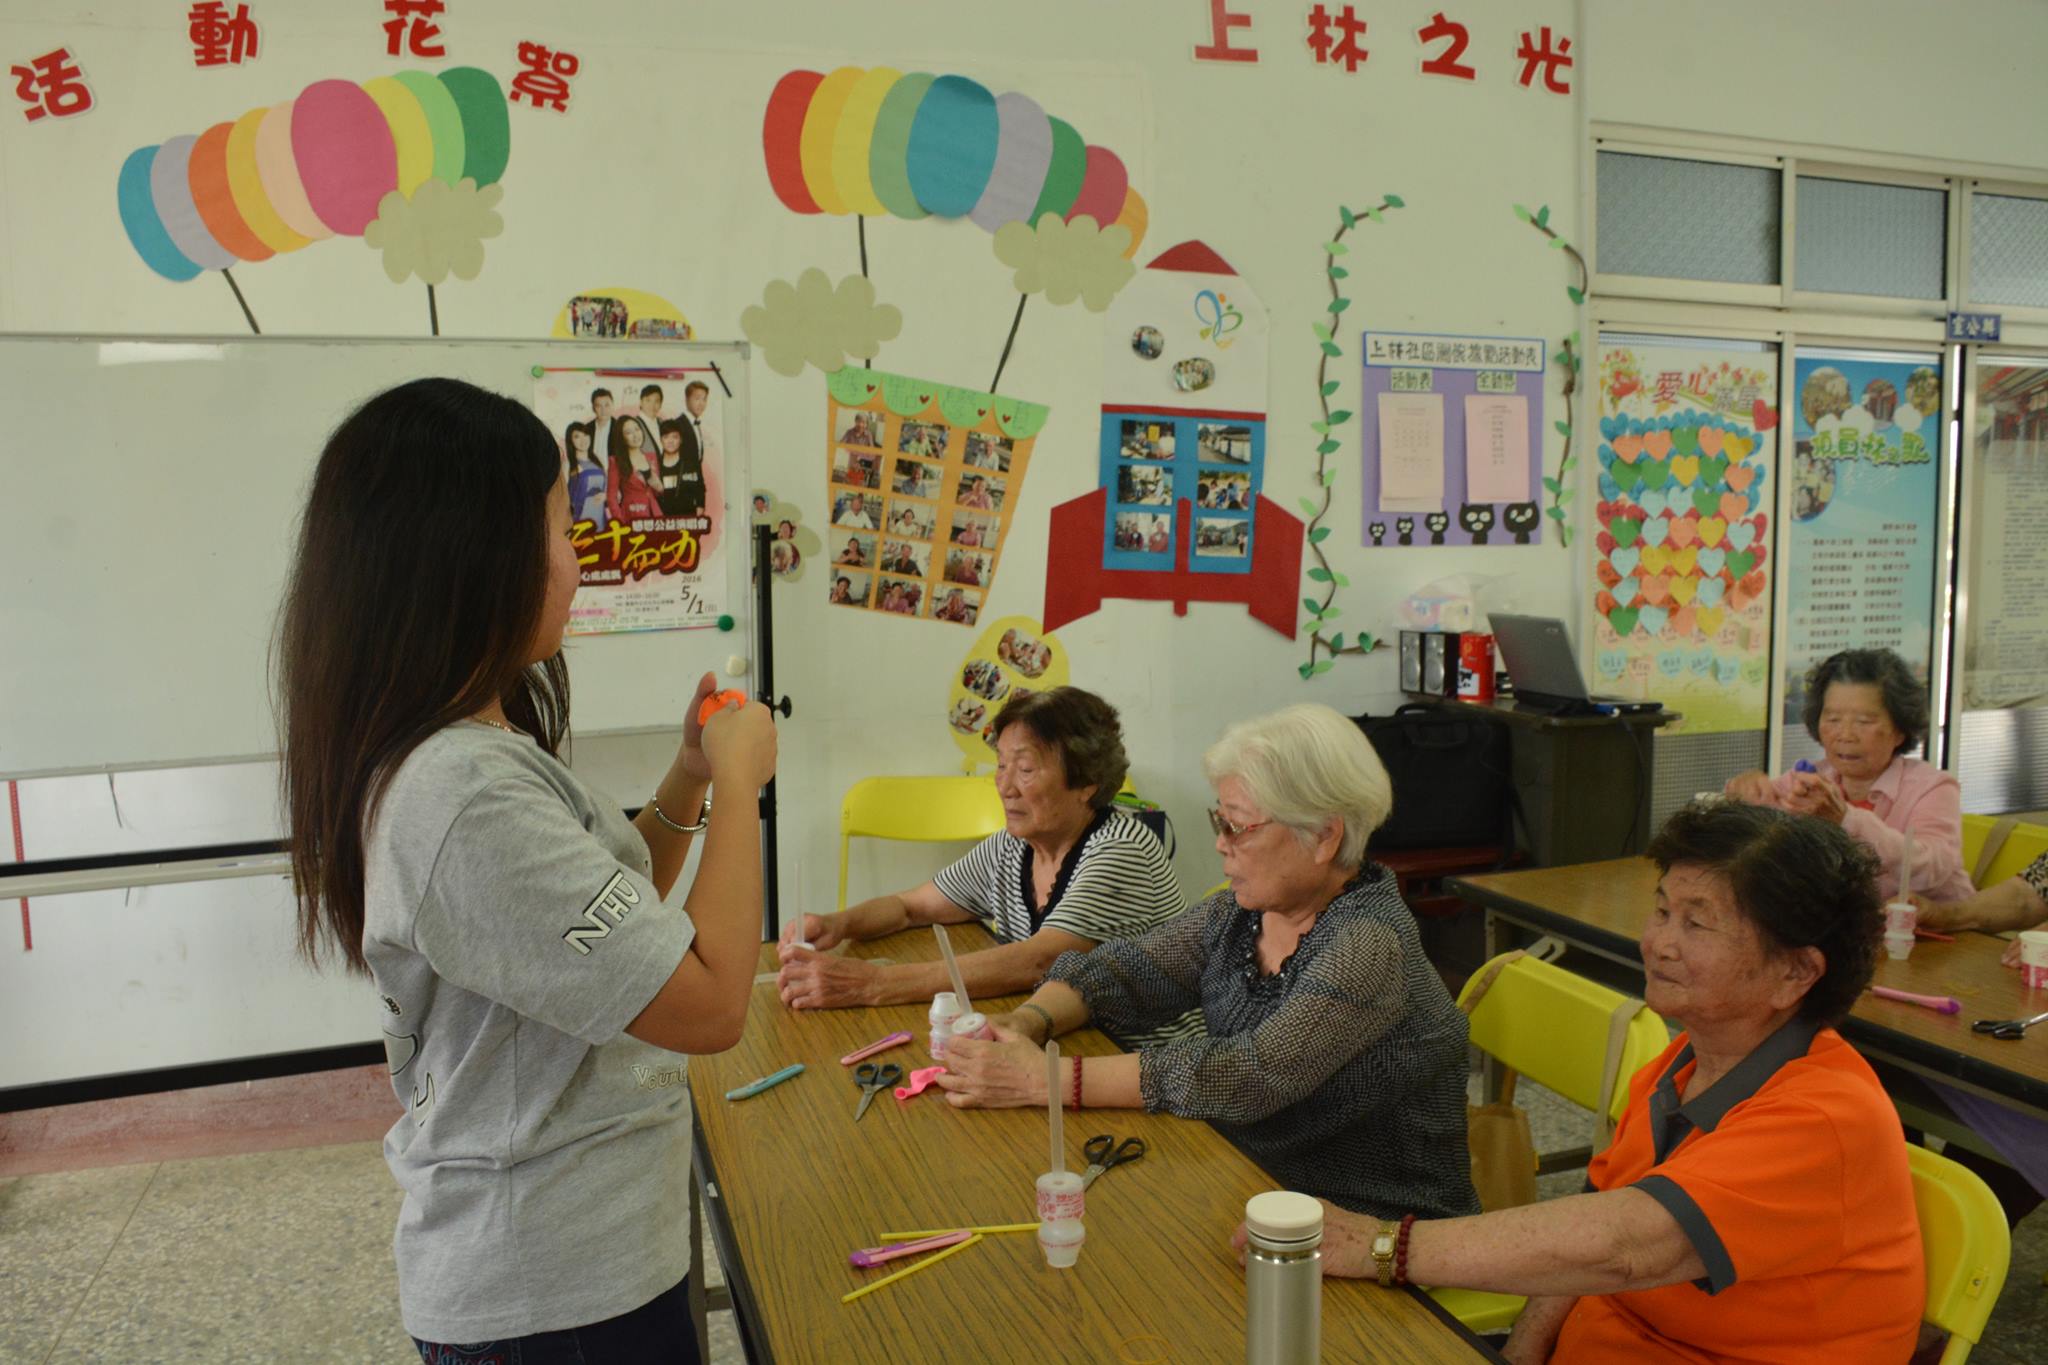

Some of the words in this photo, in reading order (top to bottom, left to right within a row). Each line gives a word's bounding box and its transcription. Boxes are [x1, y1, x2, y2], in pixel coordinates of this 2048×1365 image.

[1195, 0, 1573, 94] 上林之光
[562, 868, 641, 956] NHU
